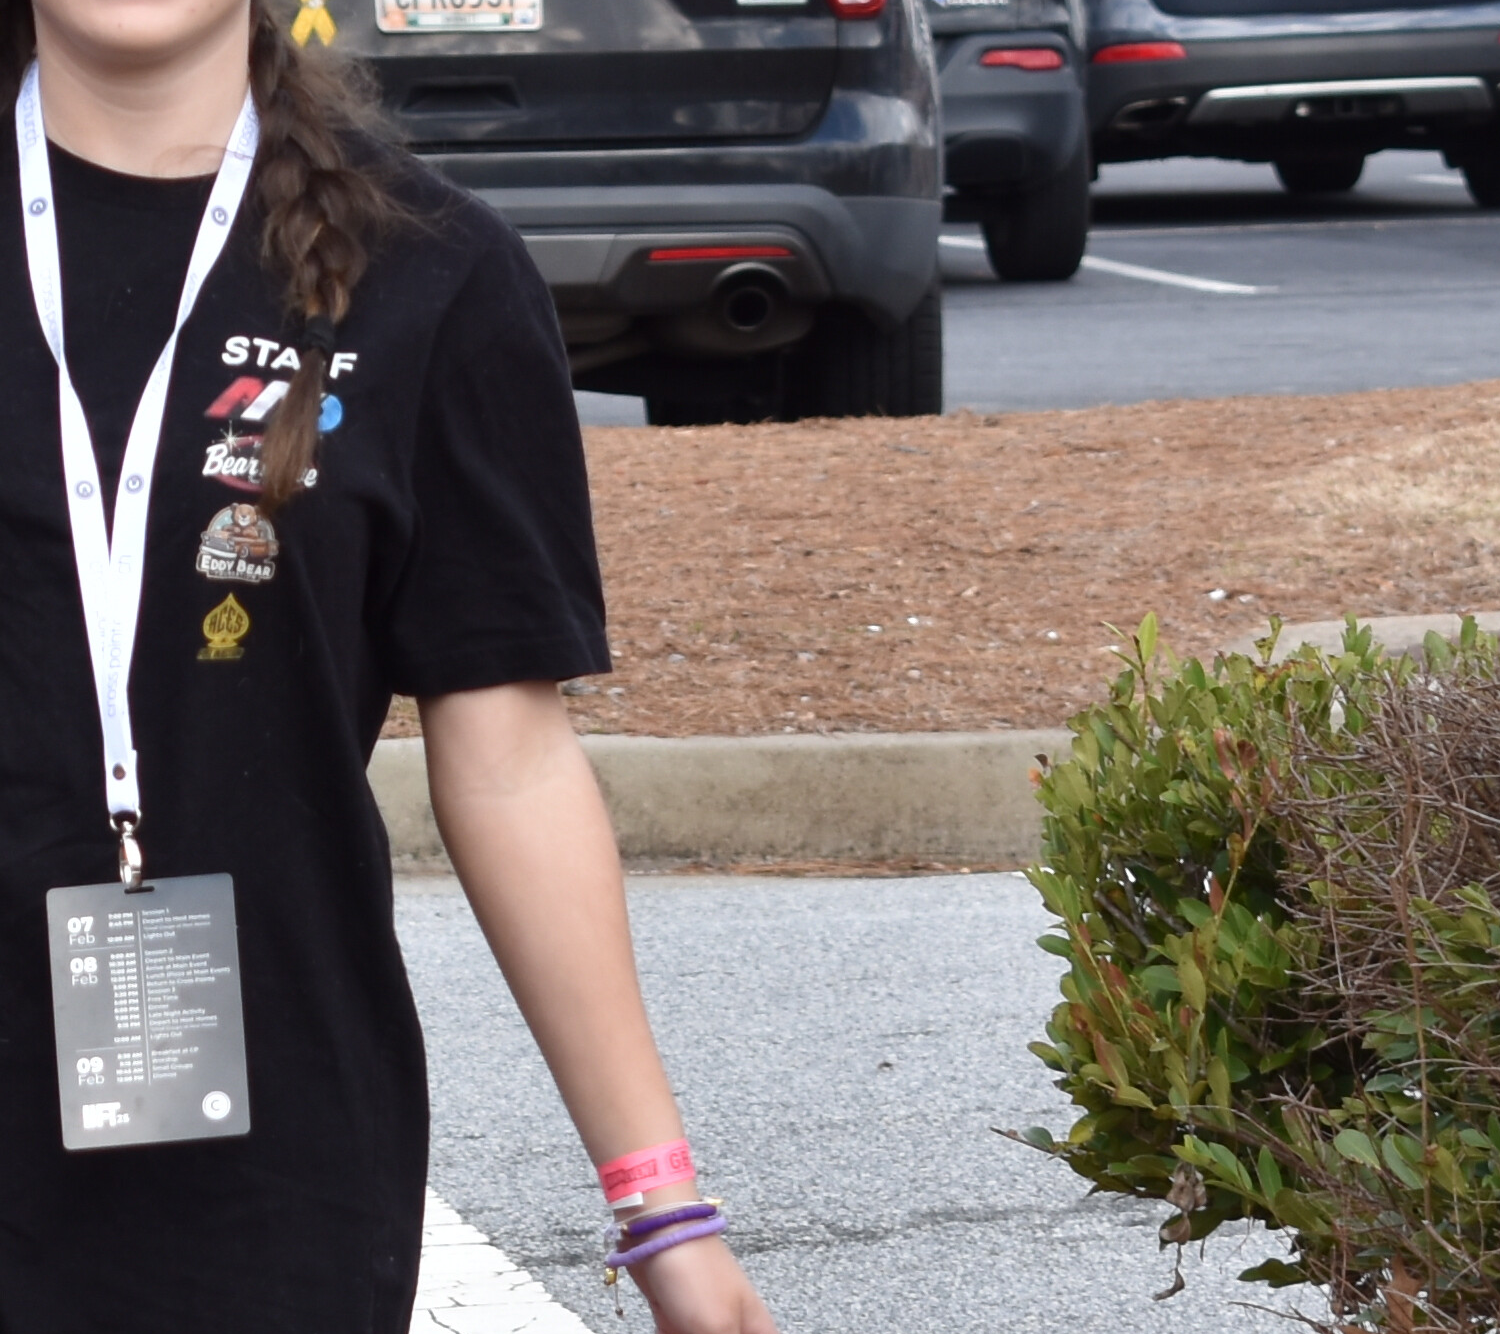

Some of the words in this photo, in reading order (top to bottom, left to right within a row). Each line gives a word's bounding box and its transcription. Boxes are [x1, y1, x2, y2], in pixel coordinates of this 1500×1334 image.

[221, 335, 359, 379] STAF
[201, 554, 236, 572] EDDY
[237, 559, 272, 577] BEAR
[208, 603, 245, 634] ACES
[67, 916, 94, 934] 07
[69, 934, 96, 946] Feb
[69, 956, 99, 975] 08
[71, 974, 99, 986] Feb
[76, 1056, 104, 1074] 09
[78, 1073, 105, 1086] Feb
